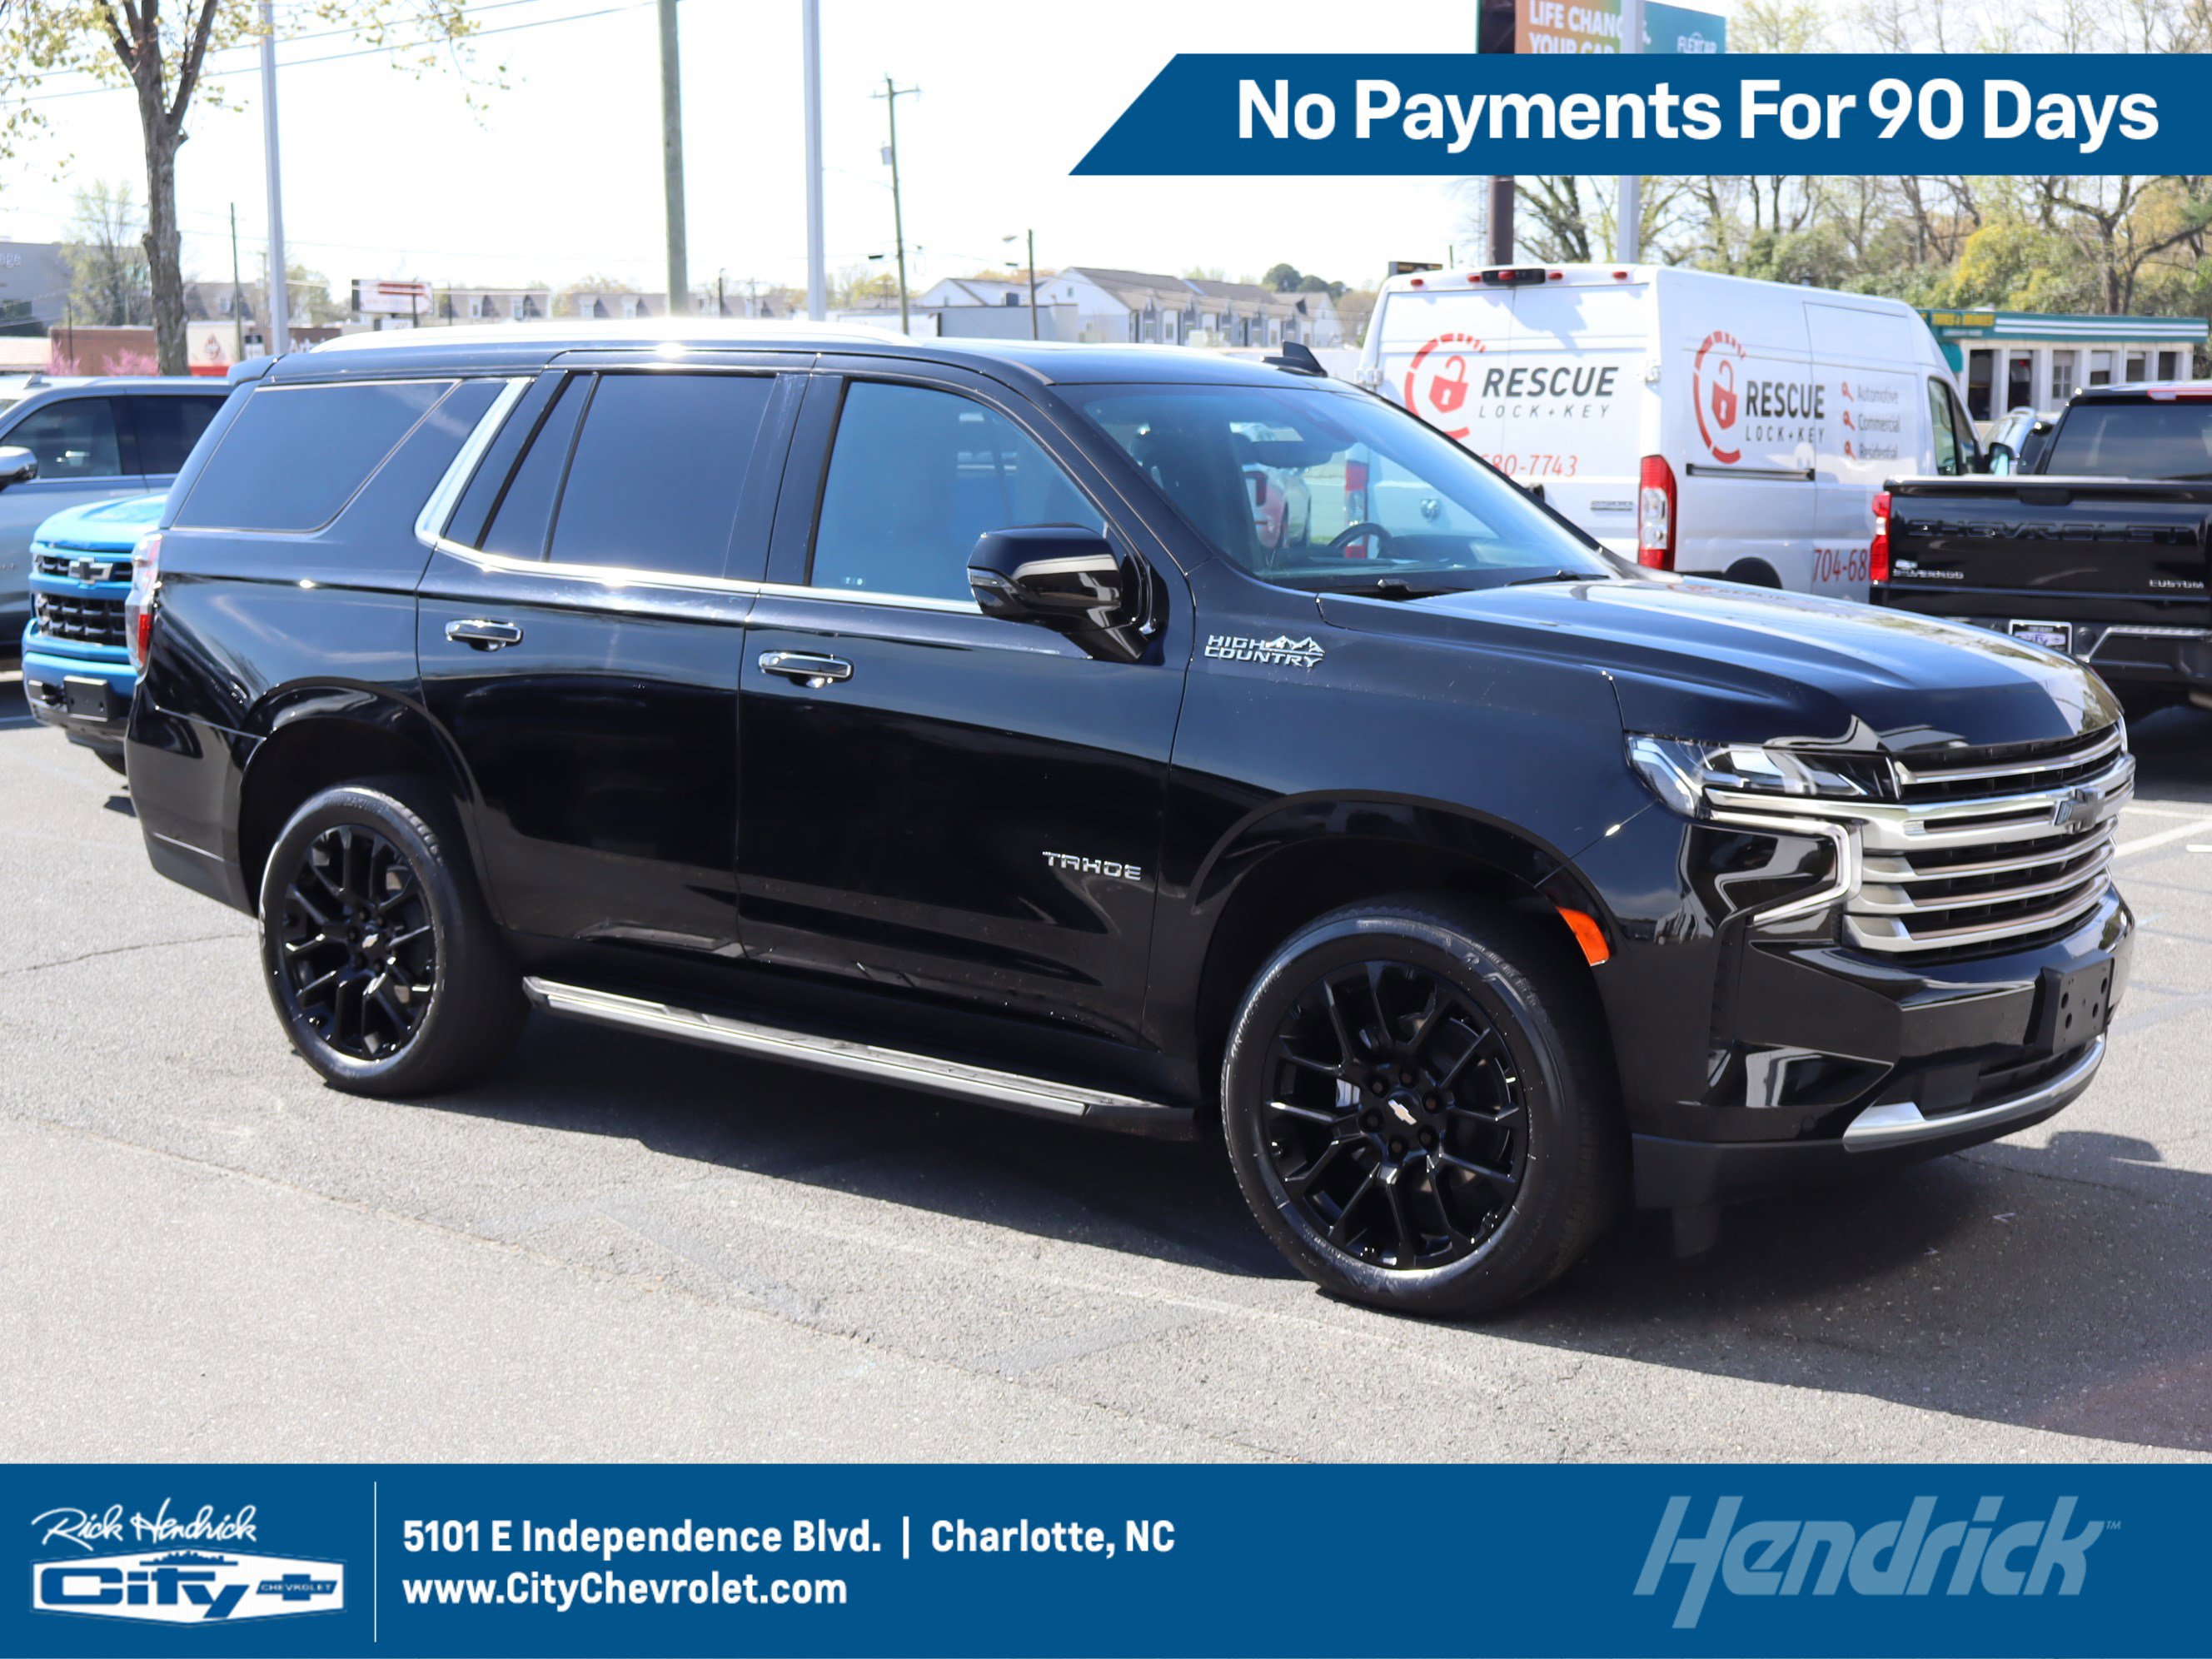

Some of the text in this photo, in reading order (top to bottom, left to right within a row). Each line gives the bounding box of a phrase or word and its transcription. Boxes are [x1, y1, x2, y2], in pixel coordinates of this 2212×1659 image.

[1529, 0, 1564, 29] LIFE
[1482, 366, 1618, 397] RESCUE
[1746, 381, 1825, 420] RESCUE
[1857, 385, 1899, 405] Automotive
[1858, 413, 1901, 432] Commercial
[1859, 442, 1898, 460] Residential
[2148, 578, 2205, 590] CUSTOM
[1208, 635, 1268, 650] HIGH
[1204, 645, 1325, 669] COUNTRY
[1043, 851, 1142, 881] TAHOE
